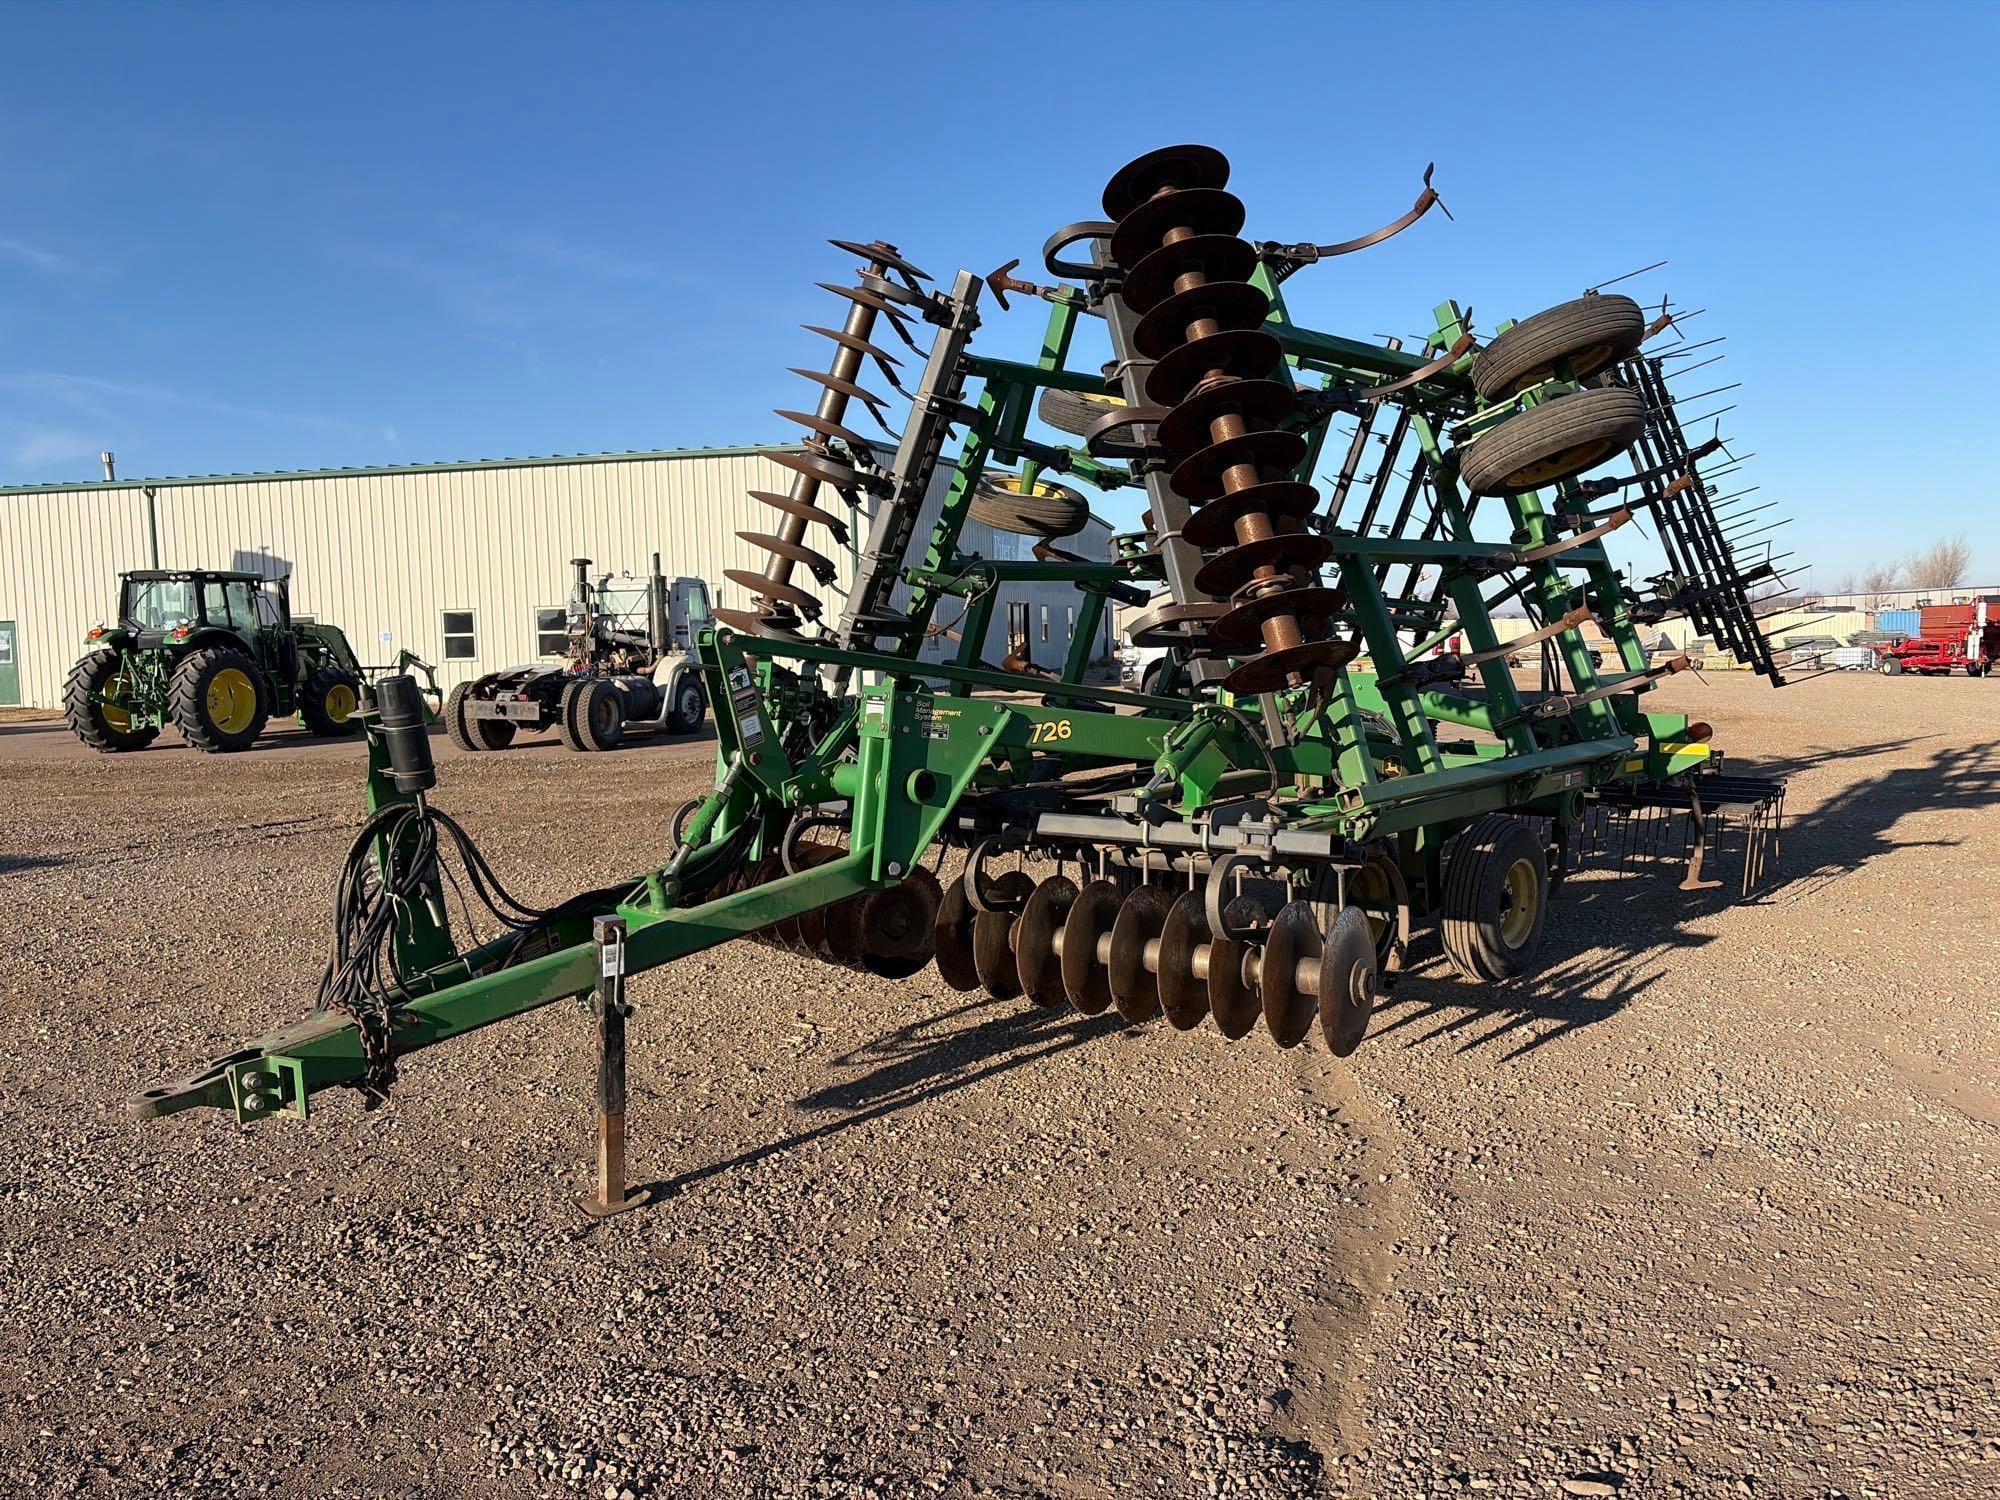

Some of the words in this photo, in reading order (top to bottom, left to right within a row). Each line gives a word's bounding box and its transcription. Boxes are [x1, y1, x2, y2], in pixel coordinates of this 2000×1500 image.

[916, 700, 930, 708] Soil
[914, 707, 962, 717] Management
[1028, 719, 1072, 744] 726
